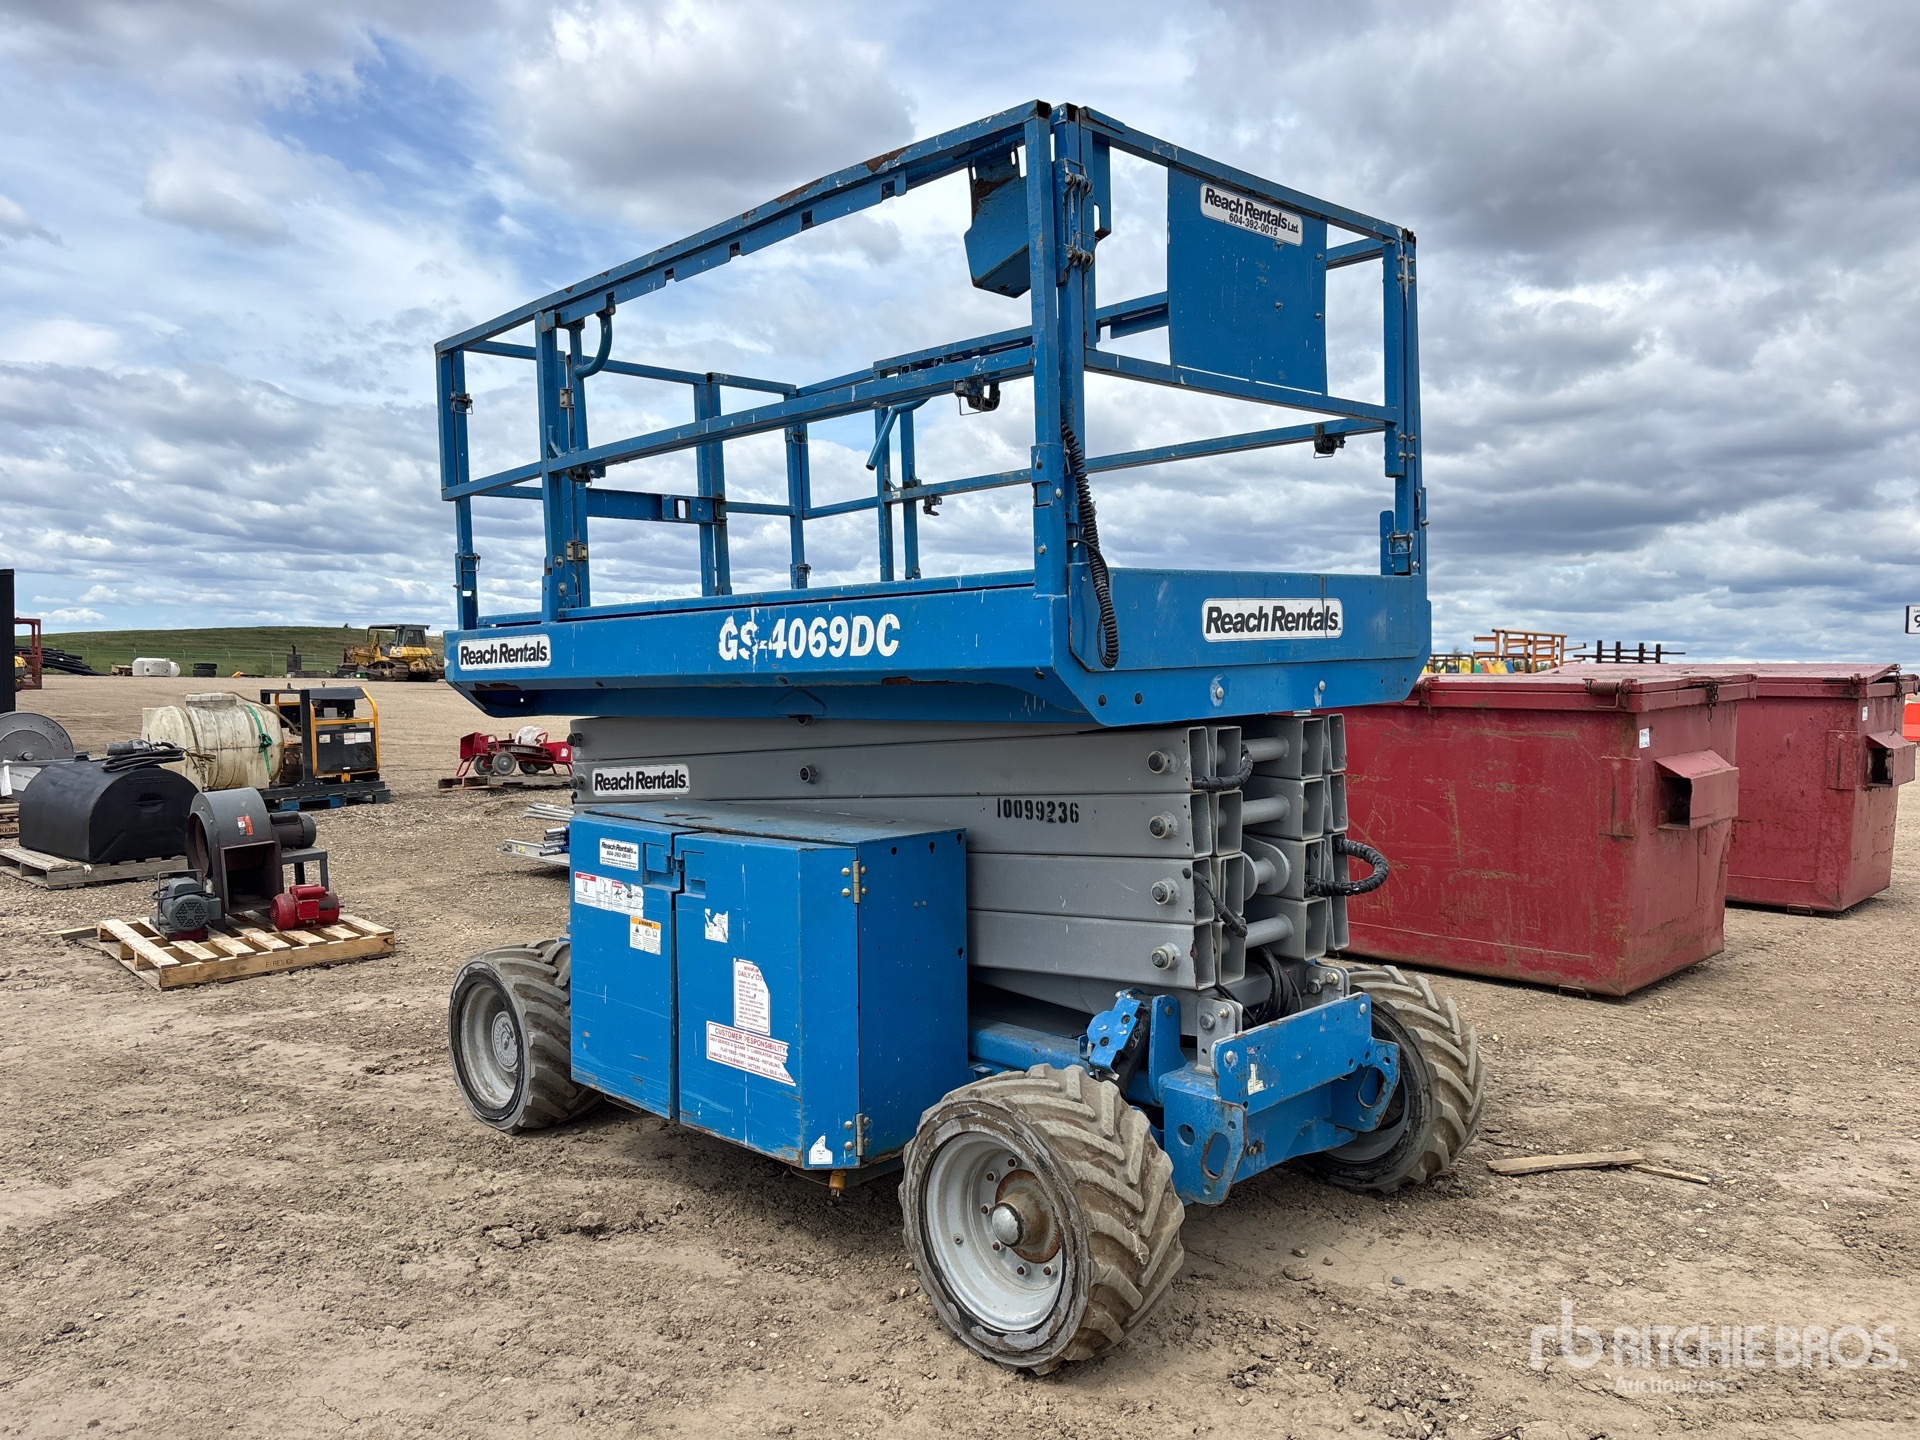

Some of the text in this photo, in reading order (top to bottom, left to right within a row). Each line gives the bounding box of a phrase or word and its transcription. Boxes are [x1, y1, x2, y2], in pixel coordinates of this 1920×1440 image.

[1204, 187, 1244, 215] Reach
[1243, 200, 1288, 230] Rentals
[1229, 212, 1278, 237] 604-392-0015
[1205, 605, 1339, 634] Reach Rentals
[718, 613, 901, 661] GS-4069DC
[460, 640, 548, 666] Reach Rentals
[594, 769, 687, 791] Reach Rentals
[997, 797, 1080, 823] 10099236
[737, 970, 751, 979] DAILY
[714, 1027, 743, 1042] CUSTOMER
